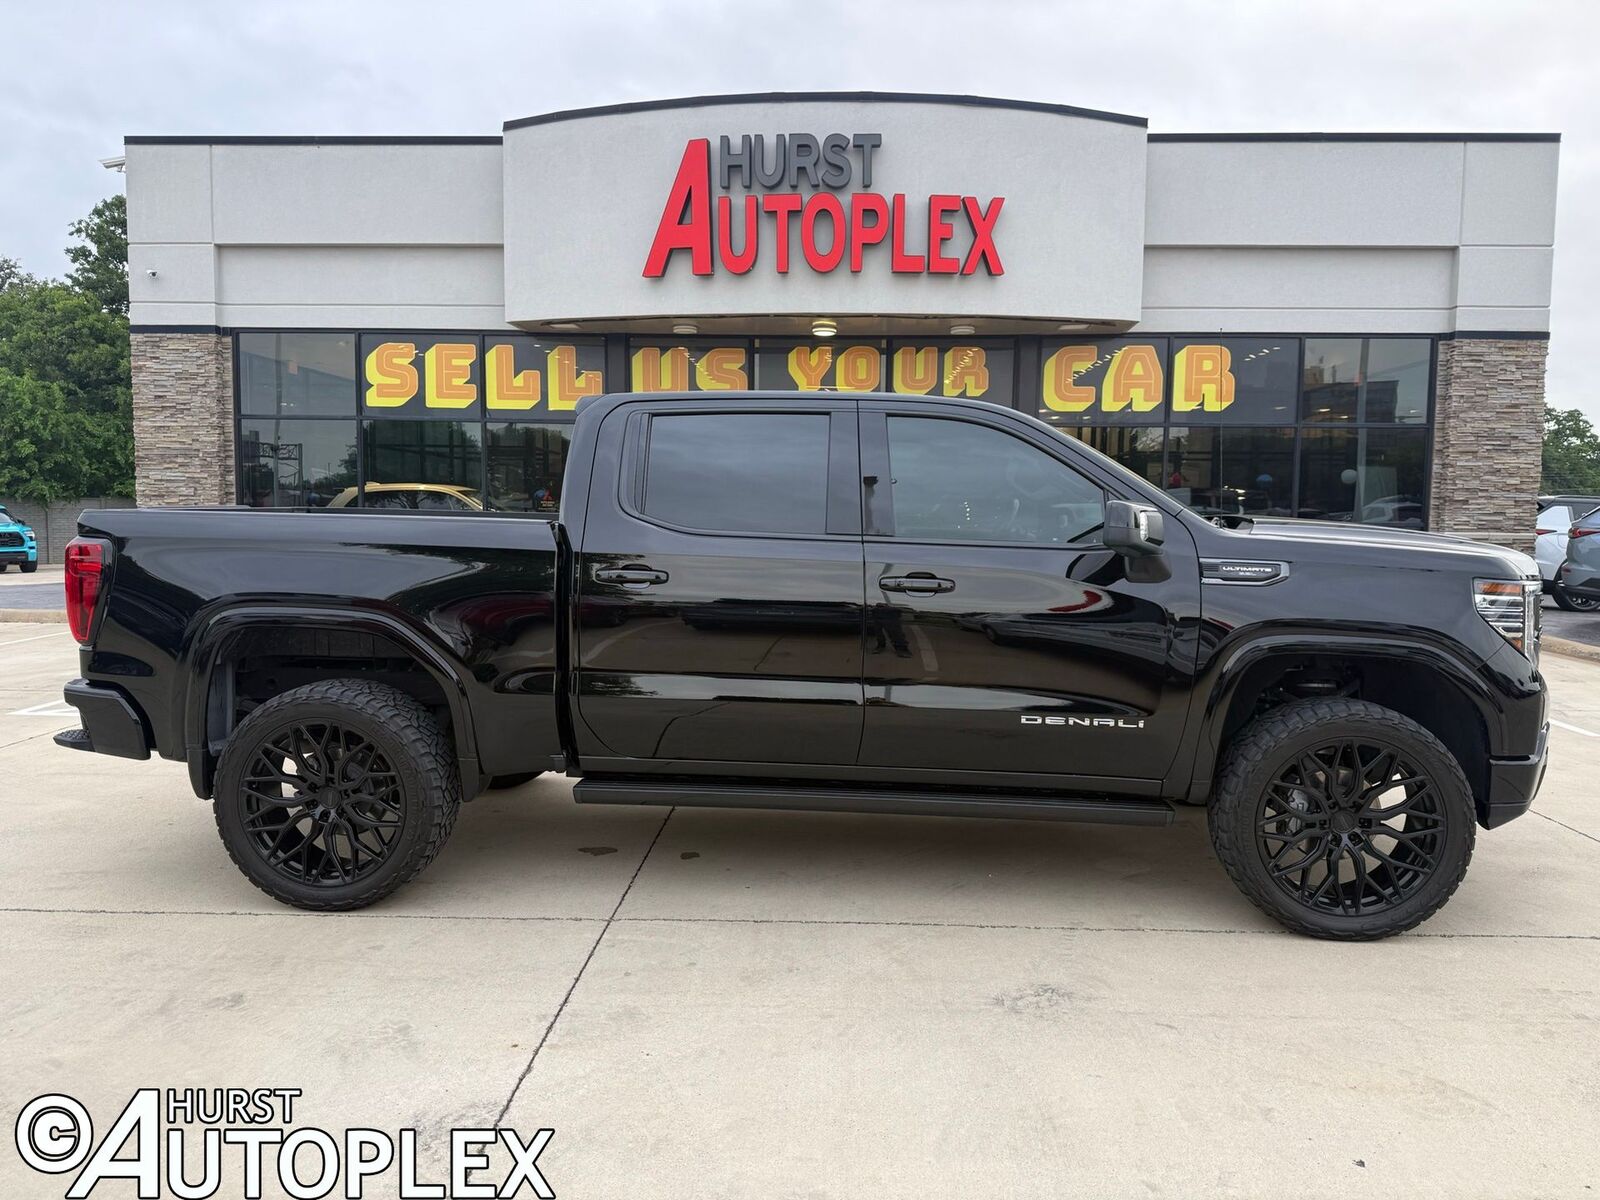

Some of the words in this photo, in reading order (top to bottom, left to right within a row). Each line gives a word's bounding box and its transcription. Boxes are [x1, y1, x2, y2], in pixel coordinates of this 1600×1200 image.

[720, 133, 882, 189] HURST
[642, 138, 1006, 278] AUTOPLEX
[366, 342, 602, 410] SELL
[632, 347, 748, 392] US
[788, 345, 989, 396] YOUR
[1043, 345, 1235, 412] CAR
[1222, 565, 1273, 573] ULTIMATE
[1020, 715, 1145, 728] DENALI
